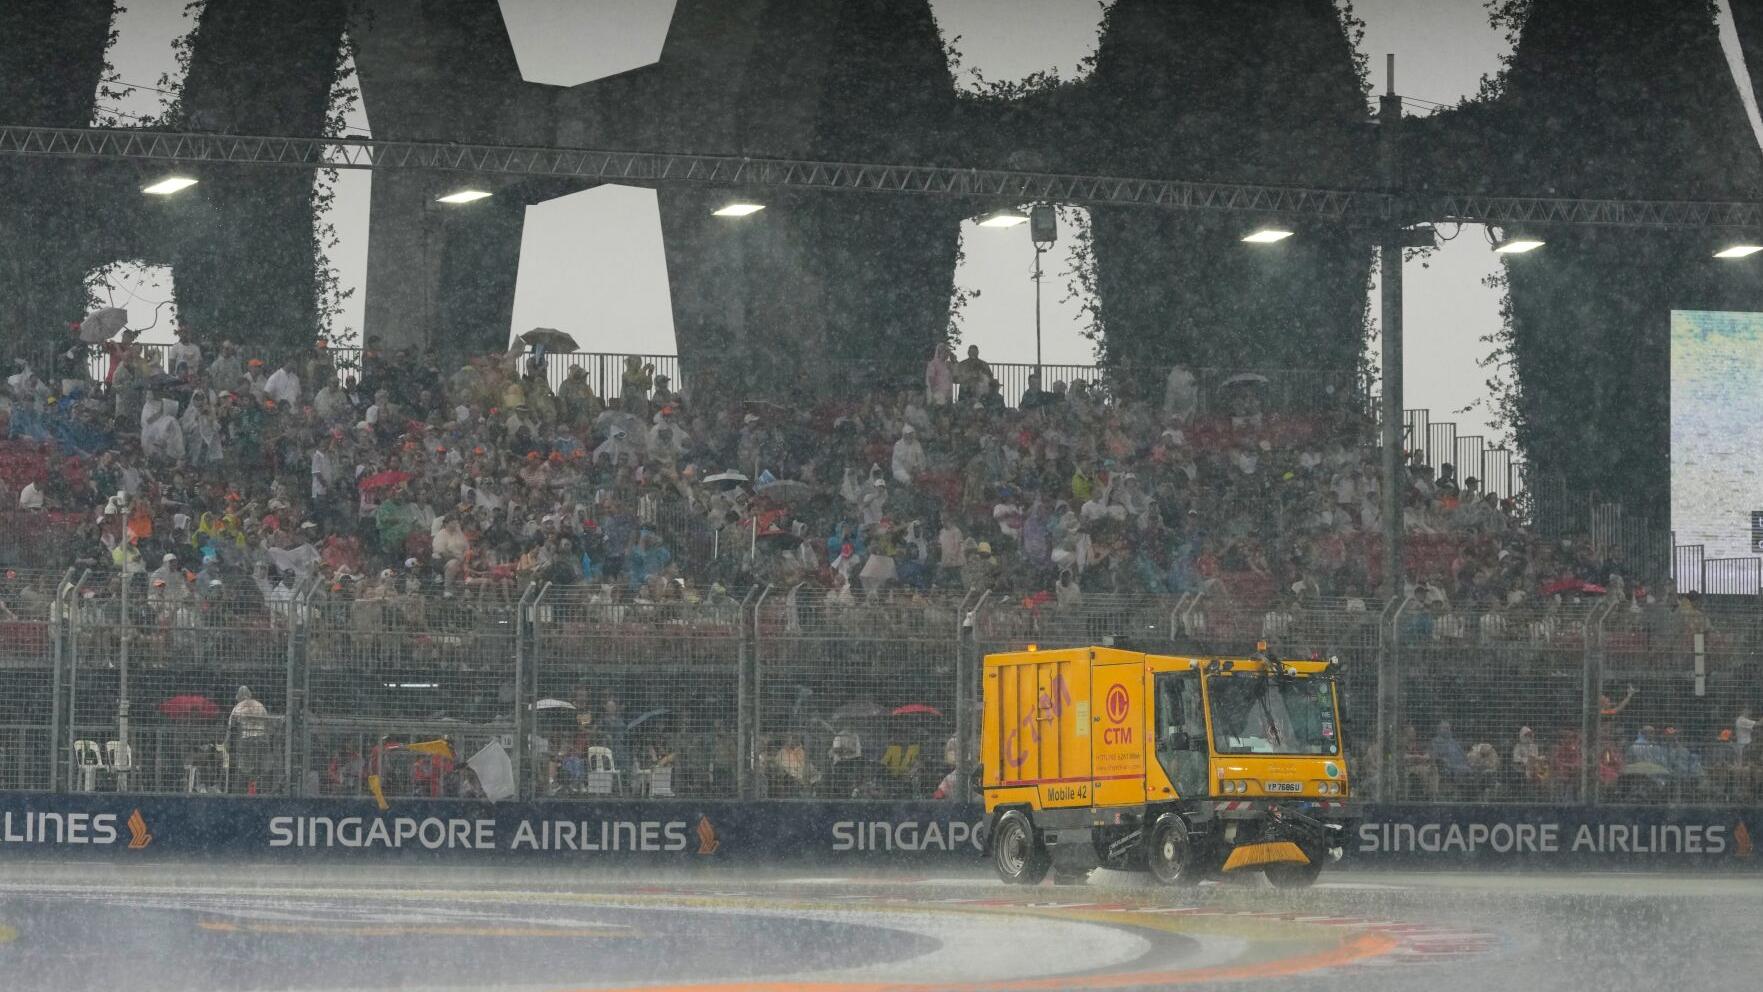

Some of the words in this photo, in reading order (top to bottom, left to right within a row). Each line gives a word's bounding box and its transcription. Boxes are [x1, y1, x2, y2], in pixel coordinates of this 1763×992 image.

[1103, 727, 1132, 745] CTM
[1047, 787, 1075, 801] Mobile
[1077, 785, 1087, 799] 42
[0, 811, 117, 843] LINES
[269, 816, 496, 849] SINGAPORE
[511, 820, 687, 851] AIRLINES
[1359, 823, 1559, 851] SINGAPORE
[1571, 824, 1726, 853] AIRLINES
